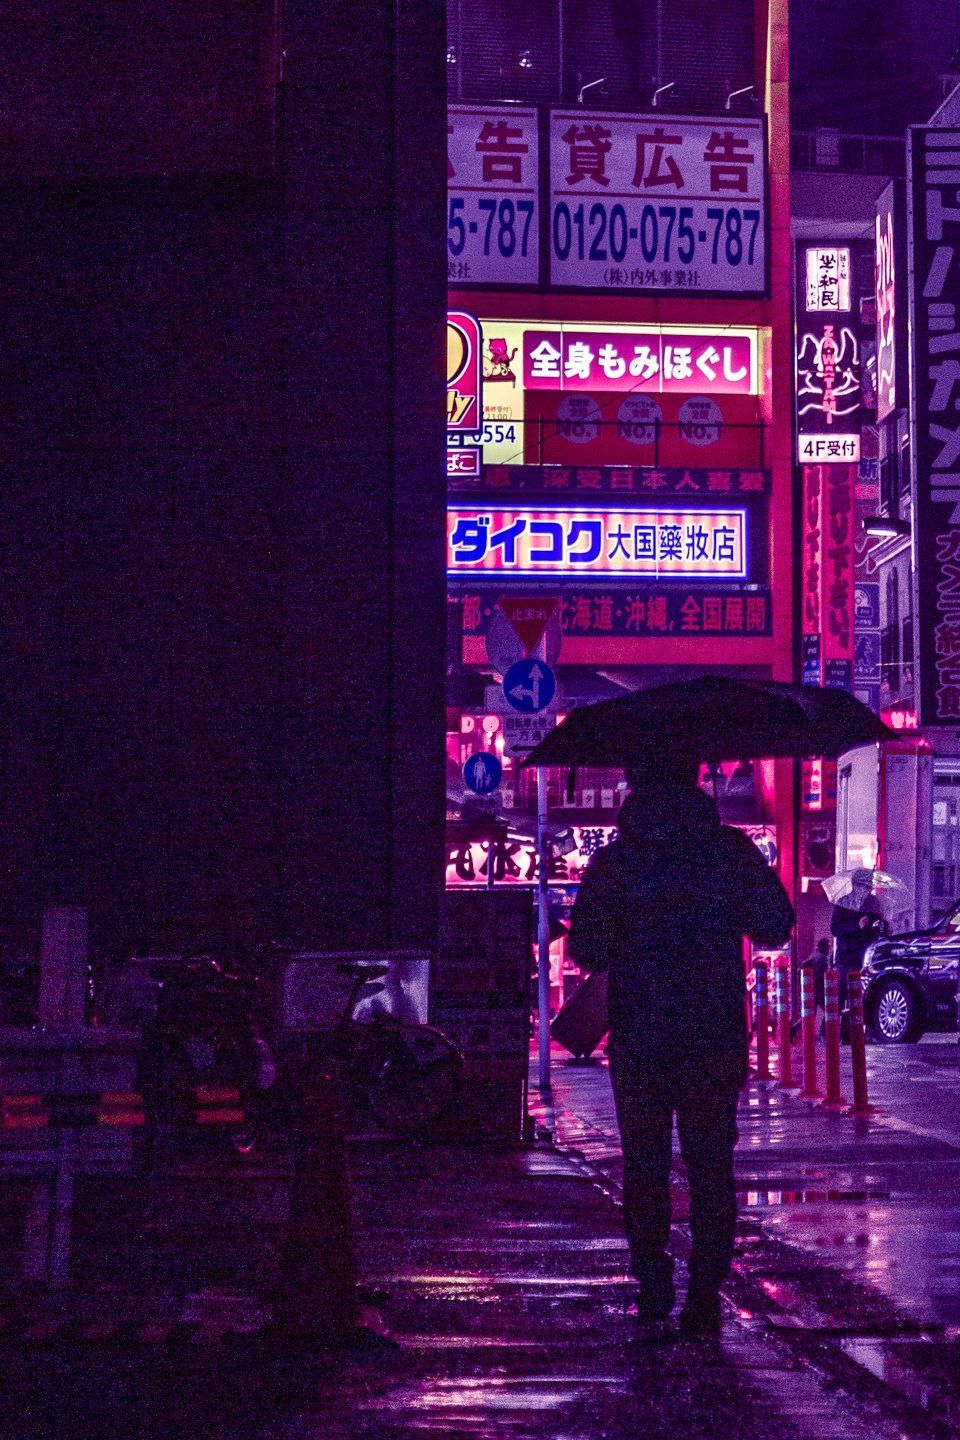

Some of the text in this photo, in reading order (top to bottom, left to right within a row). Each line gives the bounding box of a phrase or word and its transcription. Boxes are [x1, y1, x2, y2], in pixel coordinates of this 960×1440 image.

[447, 121, 528, 185] 告
[560, 127, 757, 194] 貸広告
[552, 197, 760, 267] 0120-075-787
[528, 339, 748, 383] 全身もみほぐし
[803, 439, 856, 457] 4F受付
[452, 515, 604, 566] ダイコク
[511, 608, 549, 622] 止まれ
